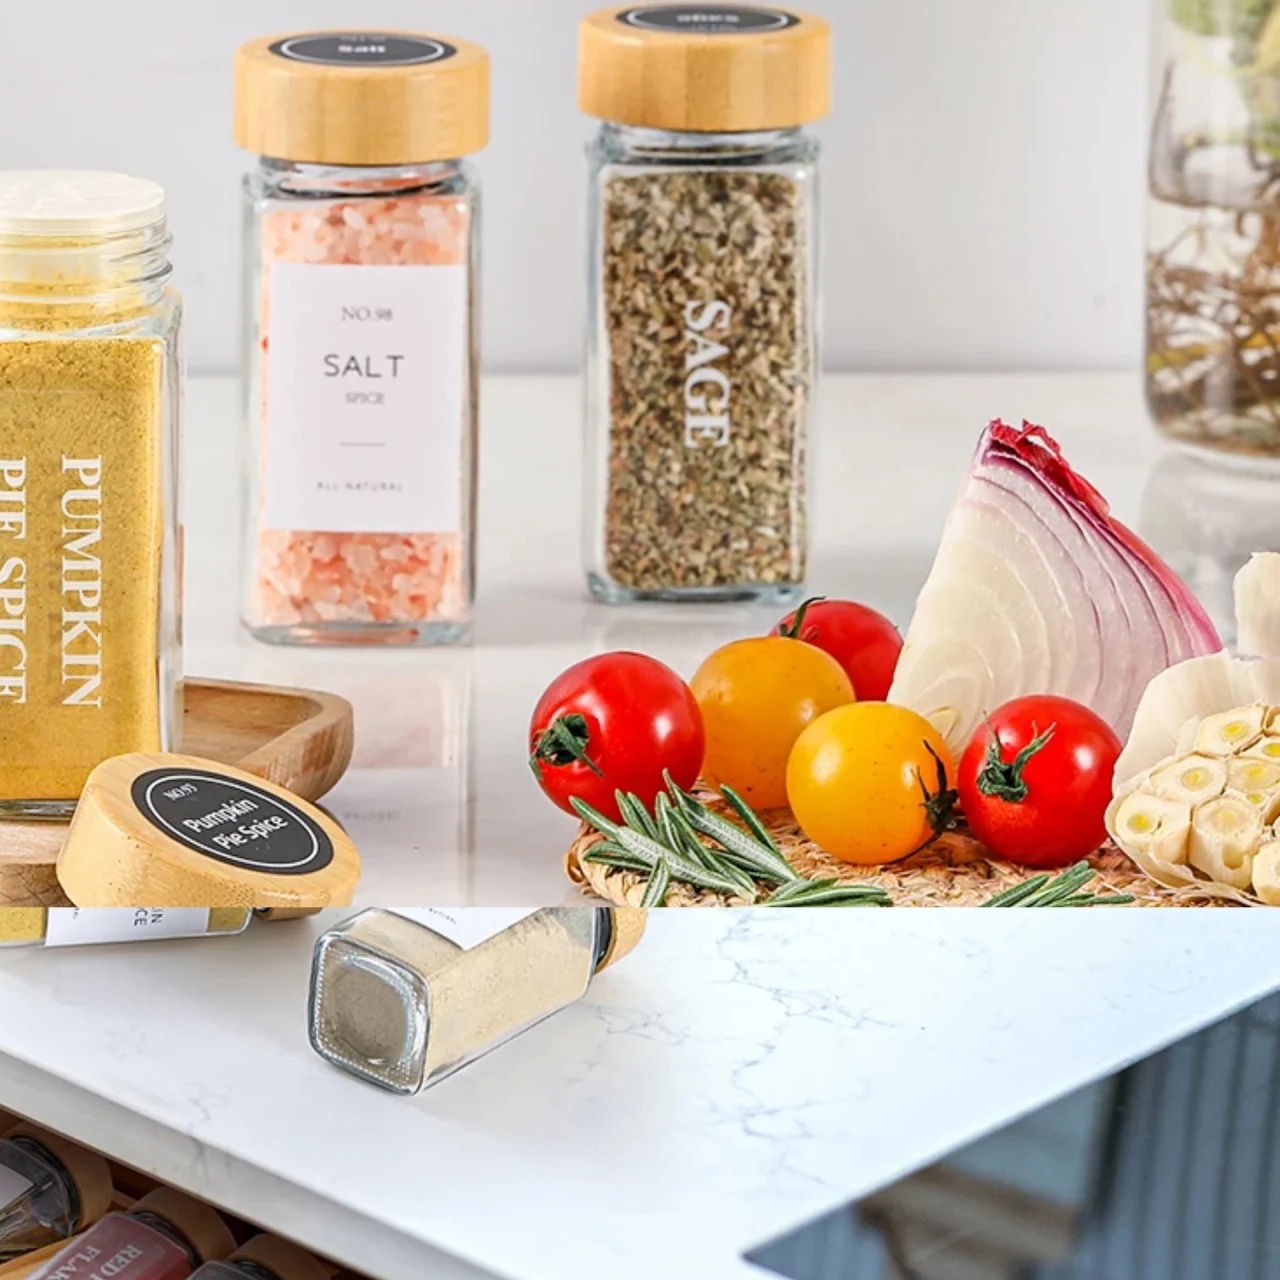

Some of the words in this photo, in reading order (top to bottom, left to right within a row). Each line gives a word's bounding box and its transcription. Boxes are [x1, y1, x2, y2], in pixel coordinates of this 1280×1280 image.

[323, 353, 405, 379] SALT
[684, 299, 731, 448] SAGE
[61, 454, 103, 709] PUMPKIN
[182, 798, 259, 833] Pumpkin
[212, 829, 248, 851] Pie
[238, 814, 289, 842] Spice
[100, 1243, 143, 1277] RED
